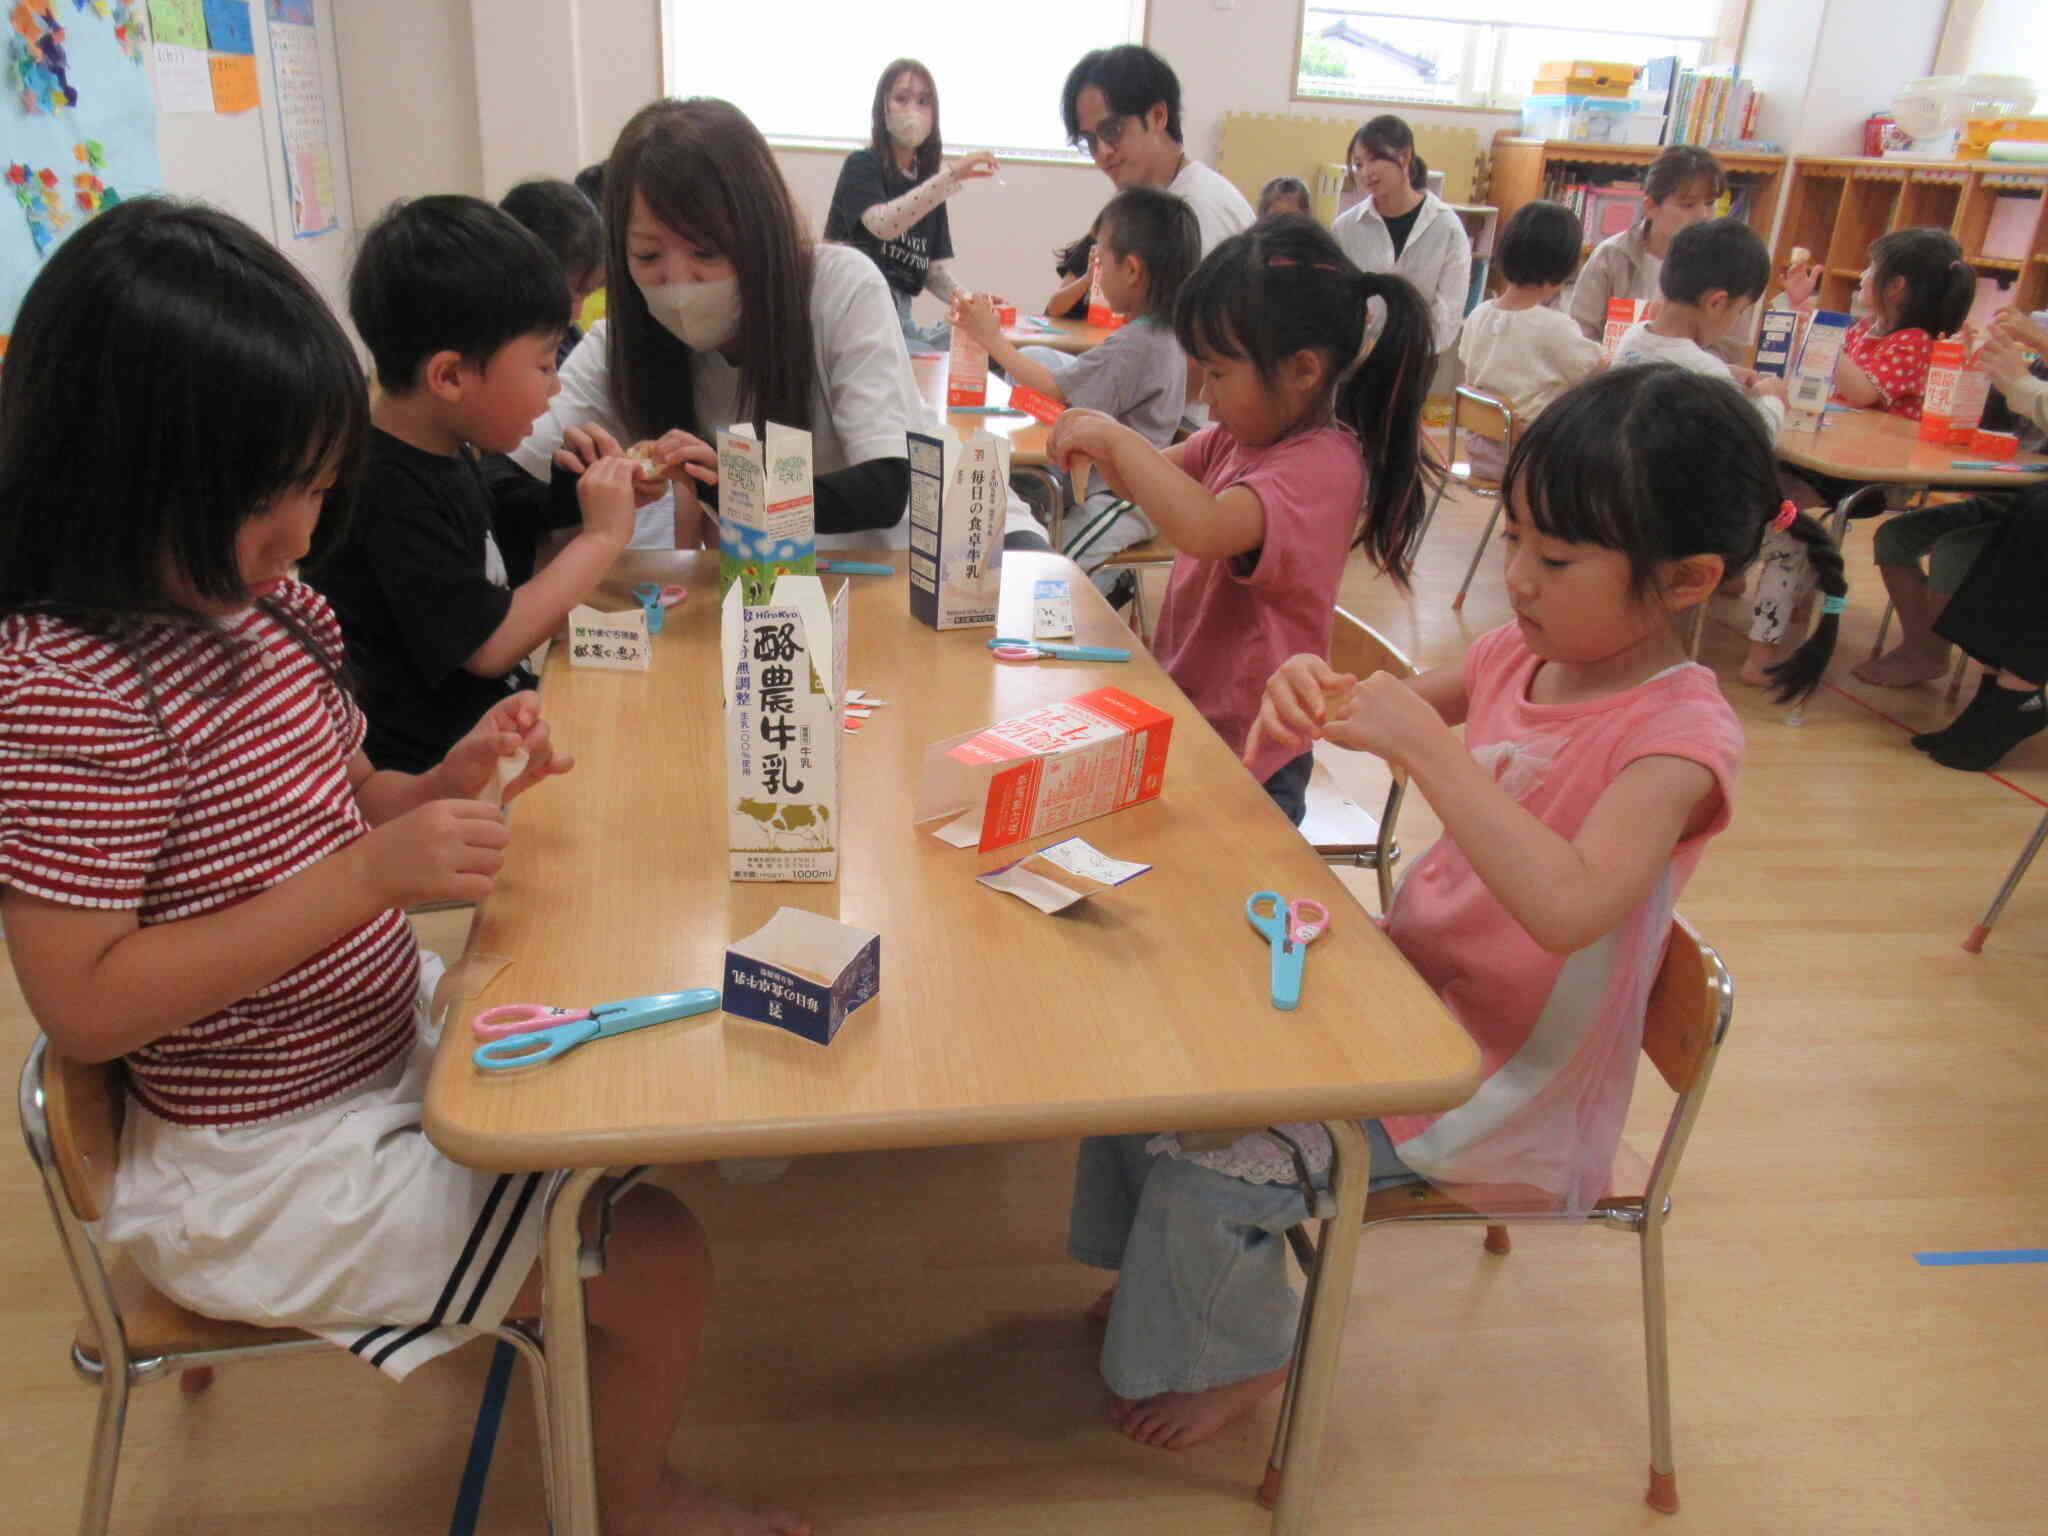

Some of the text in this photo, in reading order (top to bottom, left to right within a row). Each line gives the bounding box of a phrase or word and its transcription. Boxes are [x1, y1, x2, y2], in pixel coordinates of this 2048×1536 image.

[965, 469, 985, 579] 毎日の食卓牛乳
[755, 610, 800, 621] HiroKyo
[753, 622, 804, 794] 酪農牛乳
[792, 869, 832, 879] 1000ml
[731, 969, 820, 1013] 毎日の食卓牛乳
